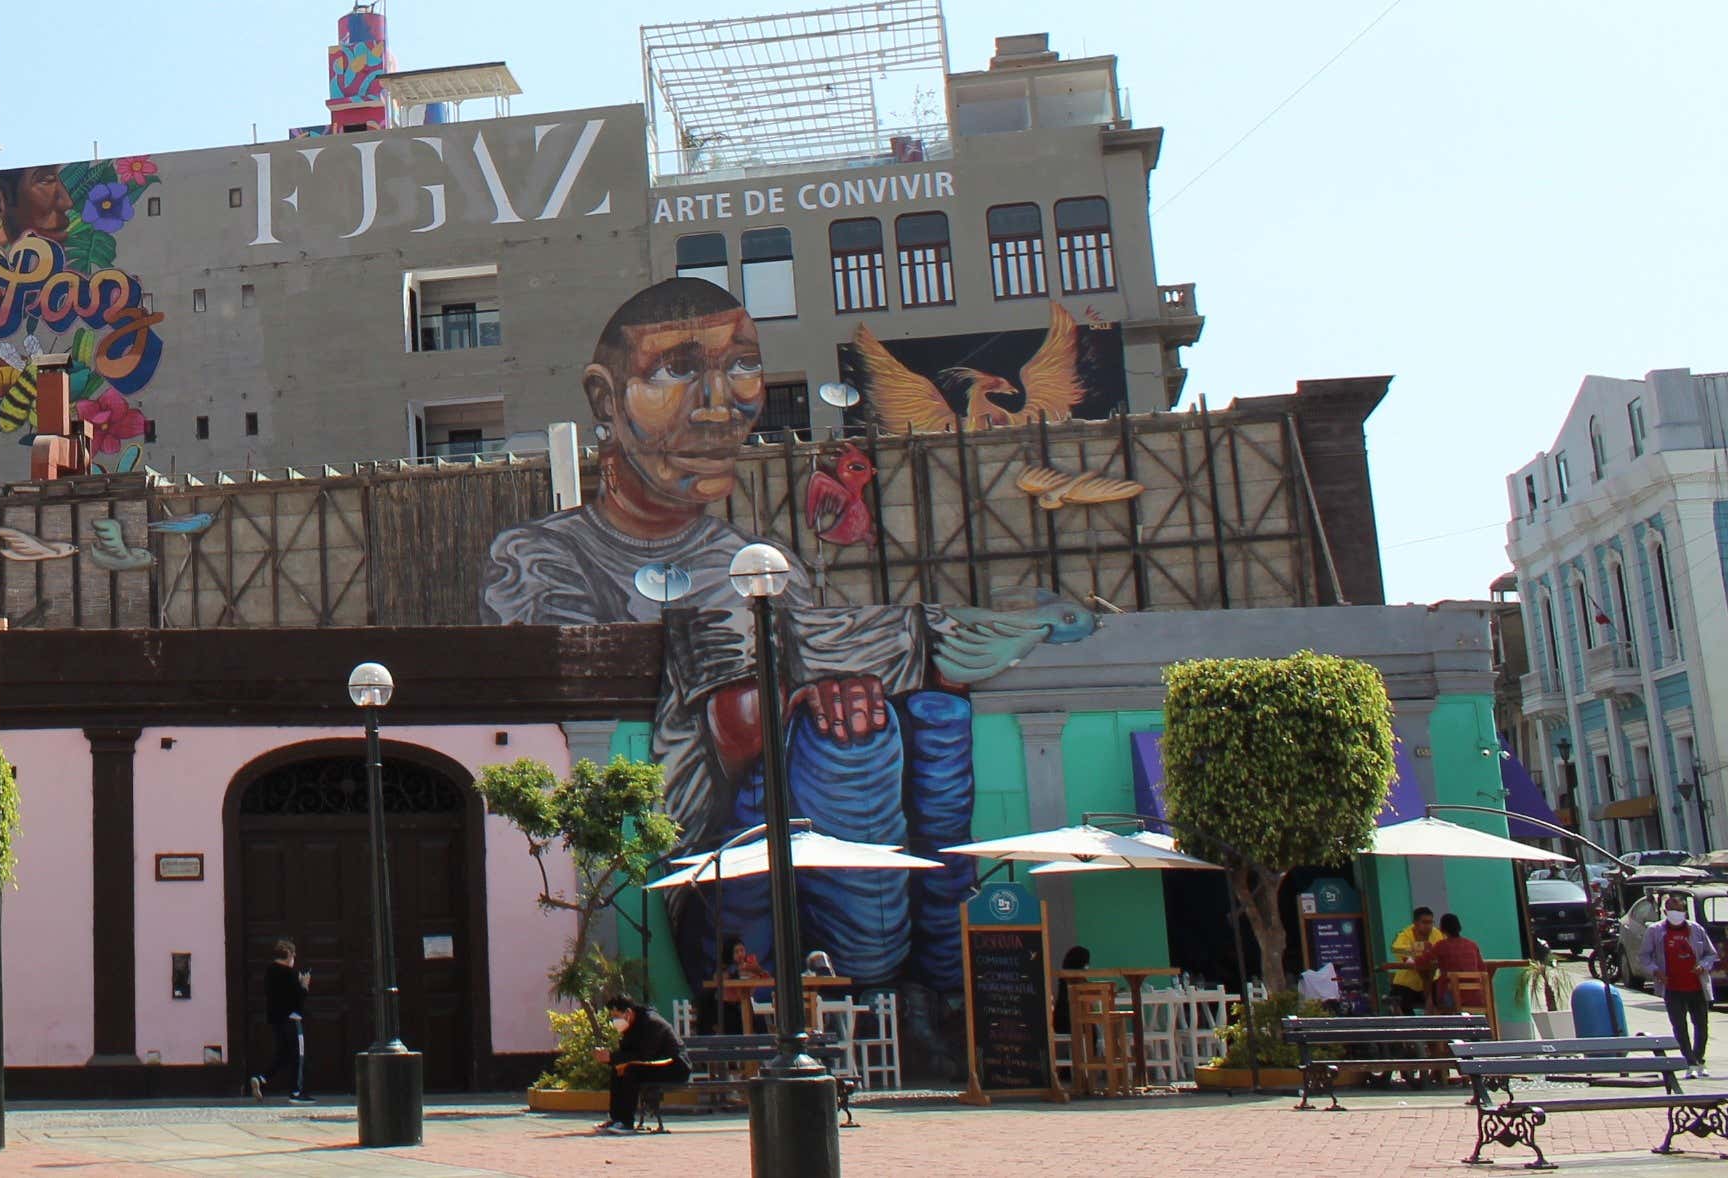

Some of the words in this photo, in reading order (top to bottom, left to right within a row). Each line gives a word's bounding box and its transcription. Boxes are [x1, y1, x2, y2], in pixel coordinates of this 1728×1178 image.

[653, 192, 733, 224] ARTE
[744, 187, 785, 217] DE
[798, 171, 956, 211] CONVIVIR
